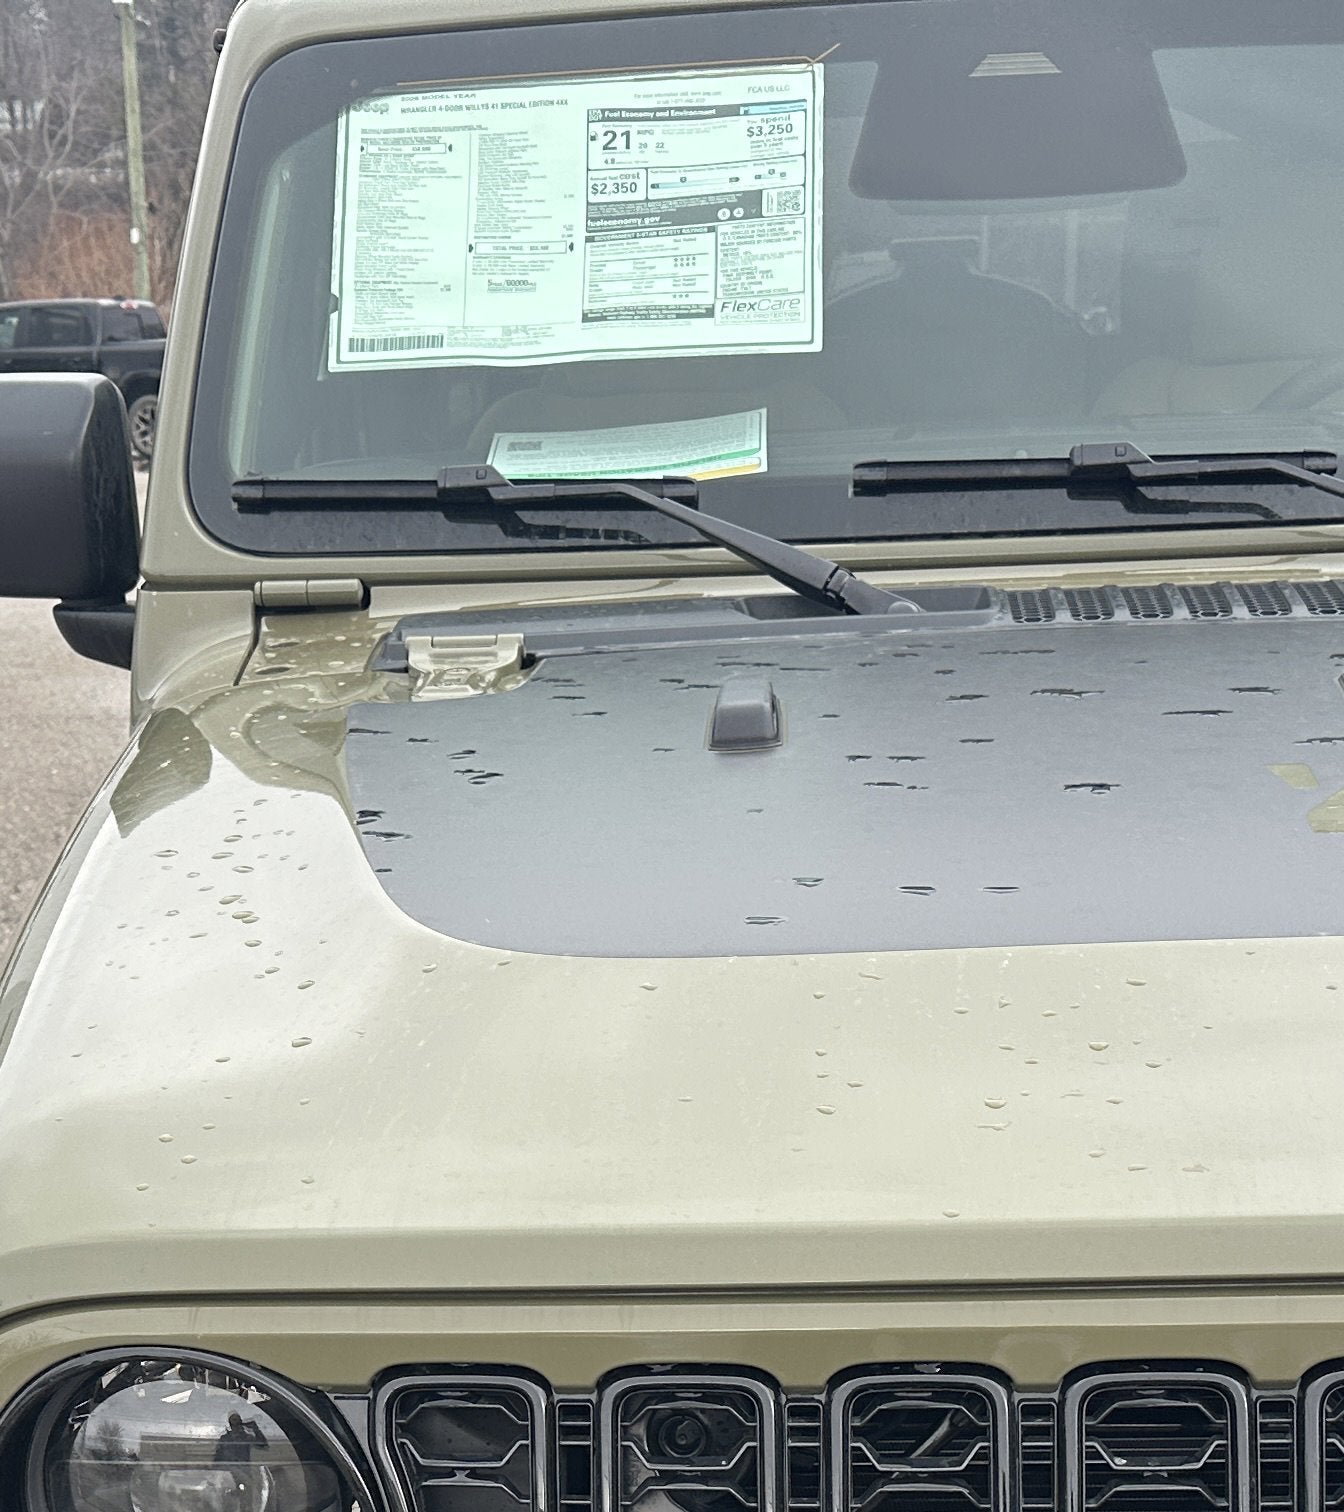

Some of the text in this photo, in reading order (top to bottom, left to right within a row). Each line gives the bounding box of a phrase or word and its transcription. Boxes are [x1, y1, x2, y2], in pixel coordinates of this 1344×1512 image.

[747, 84, 790, 94] FCA US LLC
[401, 105, 436, 114] WRANGLER
[465, 103, 489, 111] WILLYS
[500, 101, 527, 110] SPECIAL
[529, 99, 554, 108] EDITION
[605, 108, 716, 119] Fuel Economy and Environment
[746, 123, 793, 138] $3,250
[602, 130, 631, 151] 21
[619, 171, 640, 180] cost
[590, 182, 637, 196] $2,350
[720, 298, 801, 313] FlexCare
